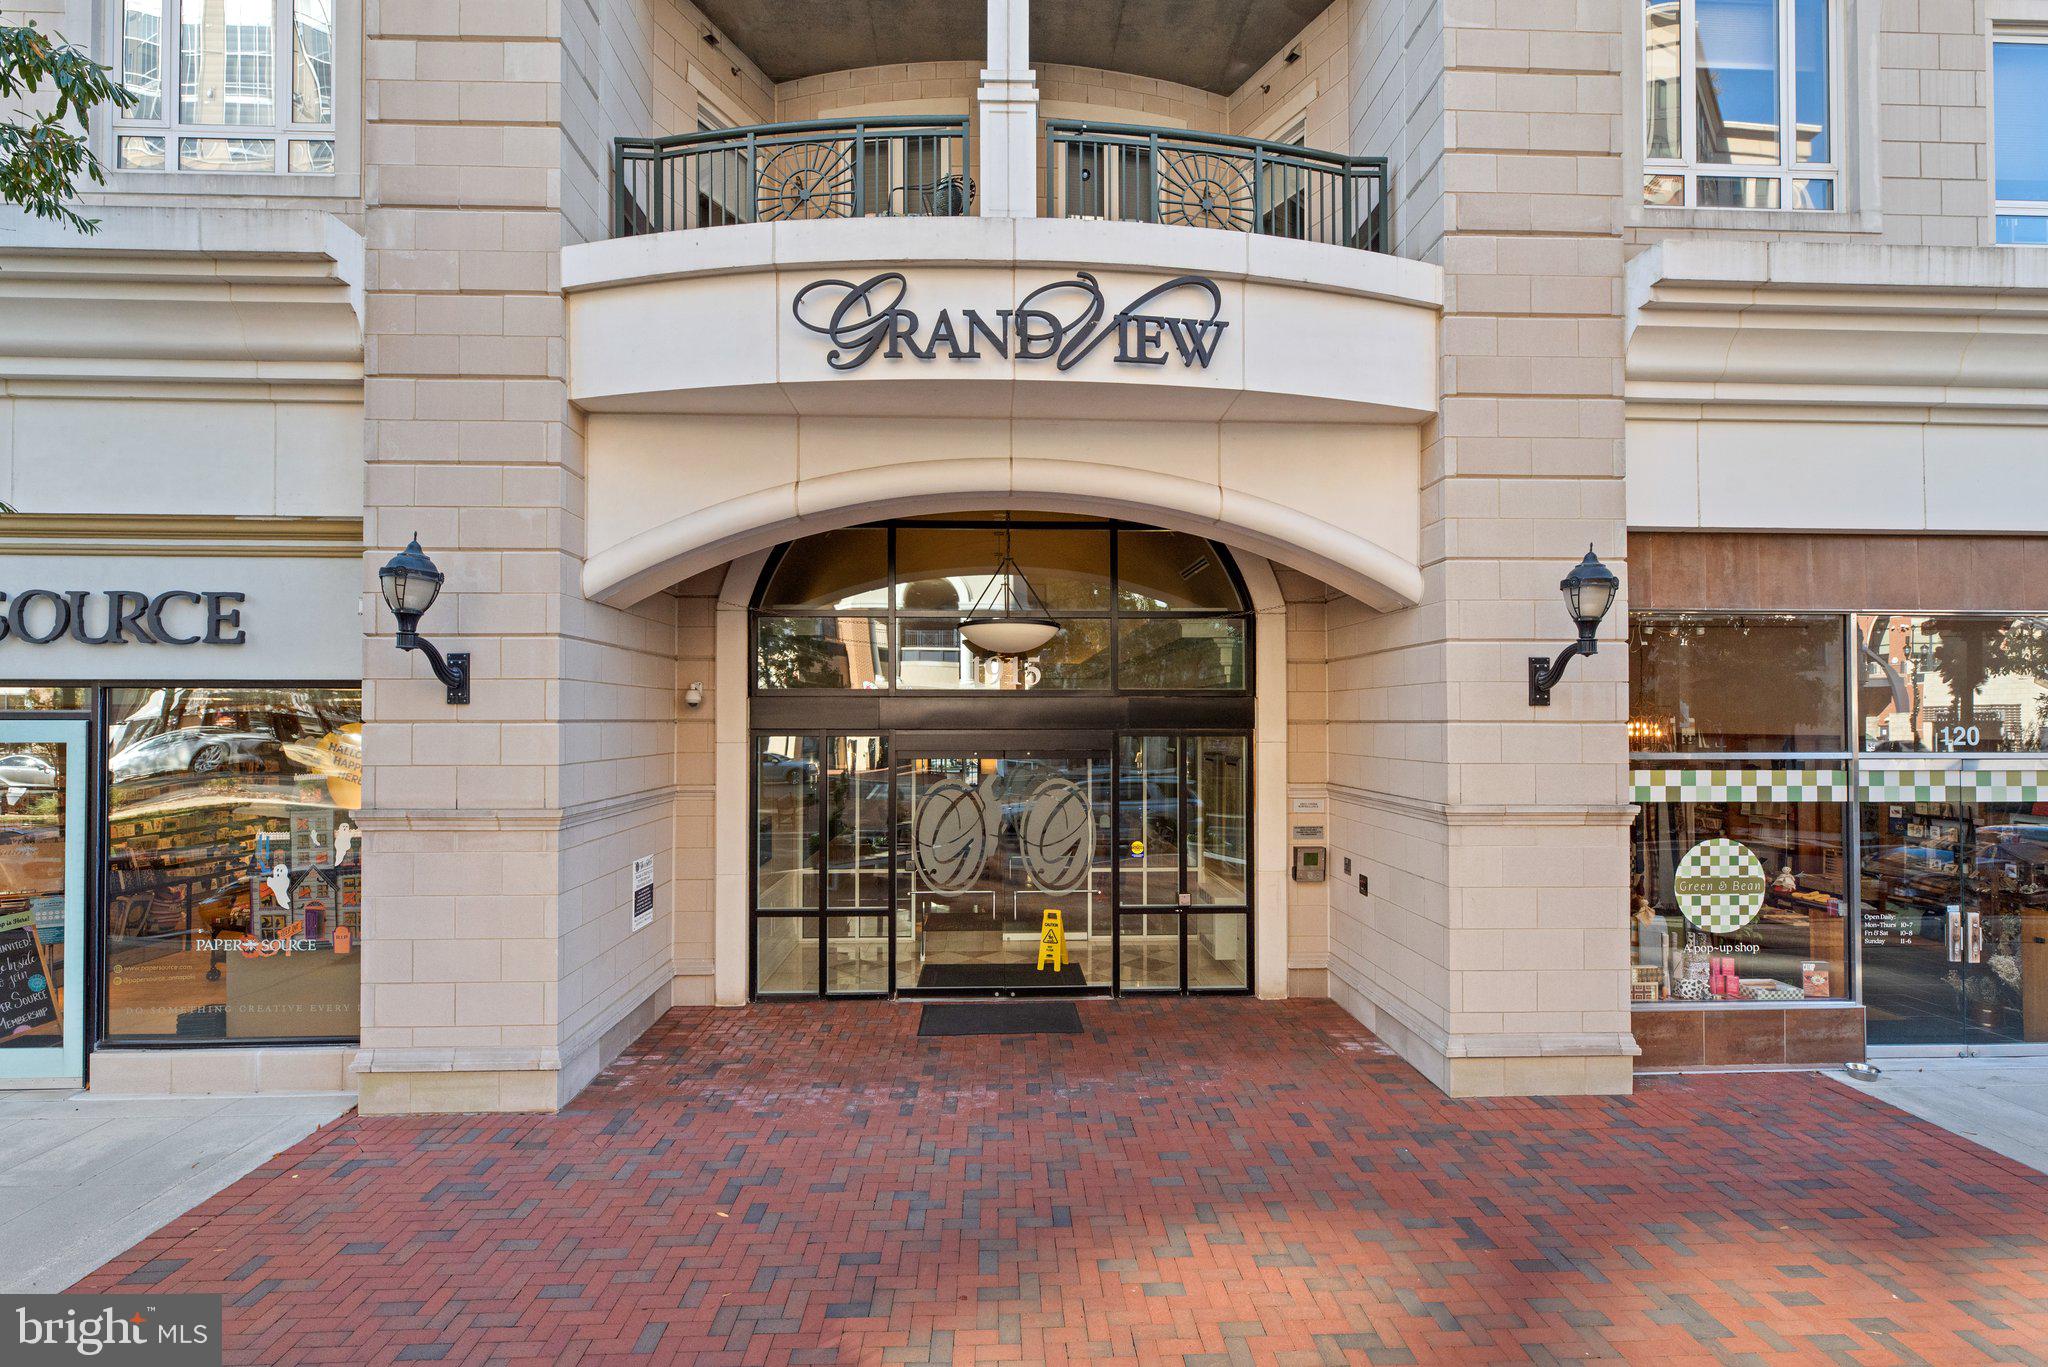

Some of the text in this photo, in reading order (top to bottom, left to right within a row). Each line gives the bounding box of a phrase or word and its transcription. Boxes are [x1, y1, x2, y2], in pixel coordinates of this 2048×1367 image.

[973, 655, 1041, 686] 1915
[1941, 726, 1980, 746] 120
[1680, 881, 1713, 891] Green
[1733, 881, 1760, 891] Bean
[196, 939, 317, 951] PAPER SOURCE
[1684, 944, 1692, 953] A
[1734, 942, 1760, 954] shop
[10, 990, 49, 1009] SOURCE
[126, 1006, 143, 1015] DO
[150, 1004, 231, 1015] SOMETHING
[239, 1004, 303, 1013] CREATIVE
[310, 1003, 350, 1012] EVERY
